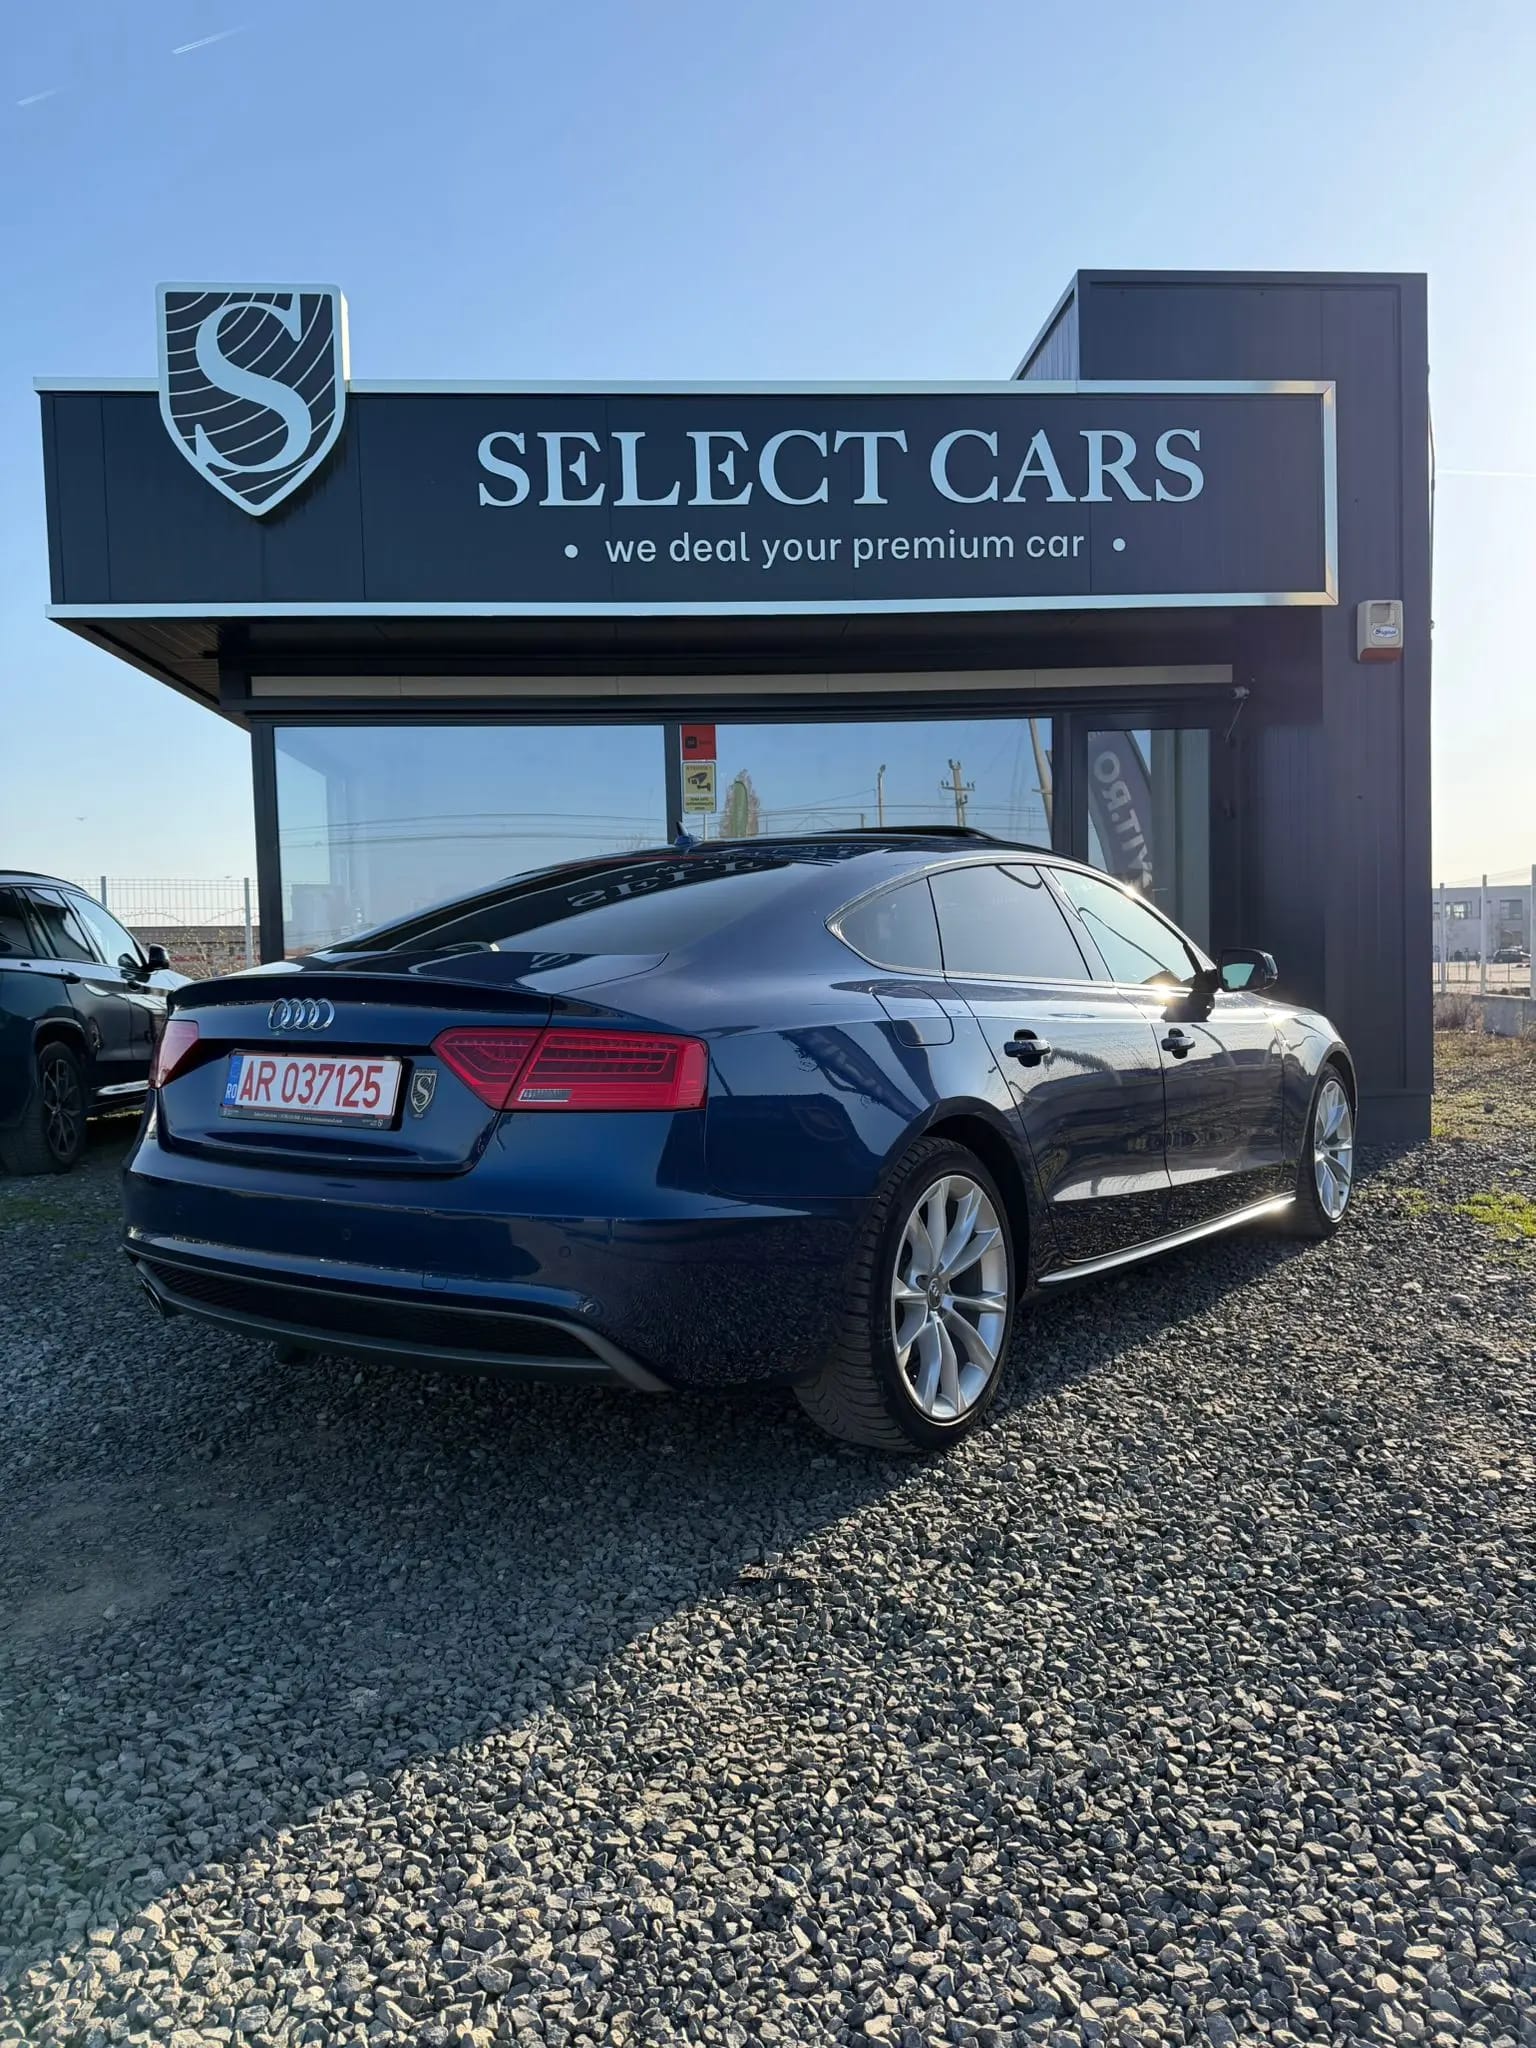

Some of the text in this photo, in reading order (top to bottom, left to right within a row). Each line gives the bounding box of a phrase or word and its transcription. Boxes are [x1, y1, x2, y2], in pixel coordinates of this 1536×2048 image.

[195, 291, 312, 473] S
[477, 428, 1204, 507] SELECT CARS
[605, 528, 1085, 569] we deal your premium car
[225, 1082, 238, 1099] RO
[239, 1060, 384, 1109] AR 037125
